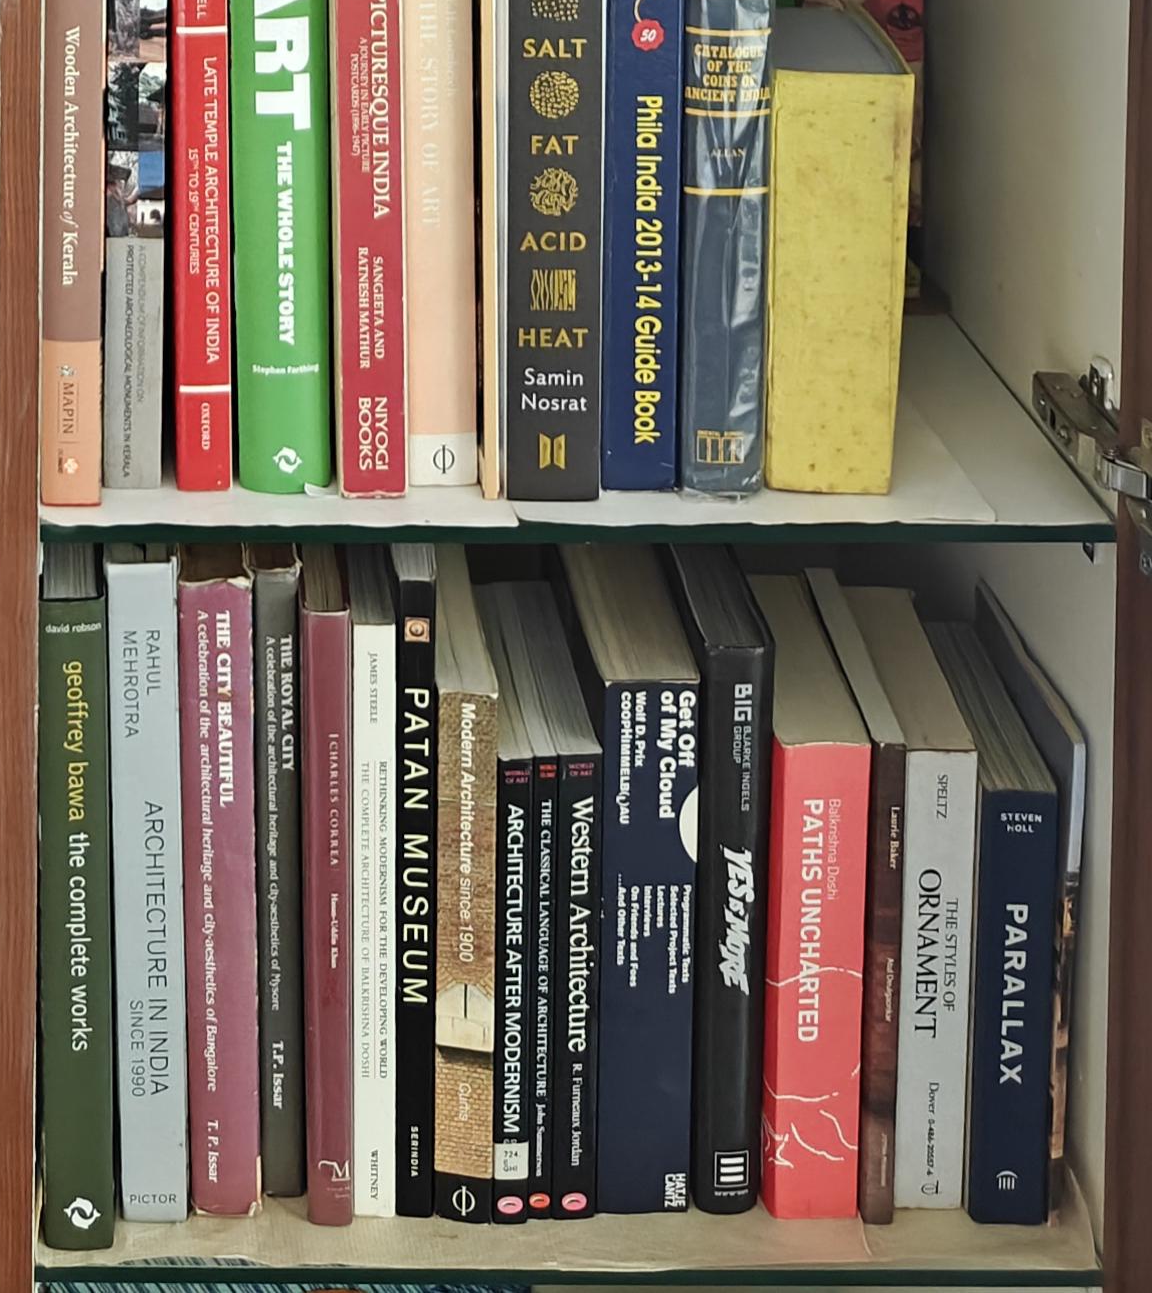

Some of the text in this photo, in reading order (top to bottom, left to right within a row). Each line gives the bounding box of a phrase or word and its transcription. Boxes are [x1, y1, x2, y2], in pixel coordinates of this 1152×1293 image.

[522, 39, 587, 60] SALT
[60, 25, 81, 286] Wooden Architecture of Kerala
[276, 141, 292, 187] THE
[277, 189, 293, 270] WHOLE
[371, 151, 391, 218] INDIA
[530, 135, 578, 156] FAT
[277, 274, 296, 345] STORY
[520, 232, 586, 251] ACID
[634, 95, 662, 444] Phila India 2013-14 Guide Book
[517, 328, 589, 349] HEAT
[215, 610, 234, 807] THE CITY BEAUTIFUL
[63, 661, 91, 1051] geoffrey bawa the complete works
[403, 687, 429, 1004] PATAN MUSEUM
[567, 796, 593, 1052] Western Architecture
[797, 798, 824, 1042] PATHS UNCHARTED
[913, 868, 940, 1038] ORNAMENT
[999, 904, 1028, 1085] PARALLAX
